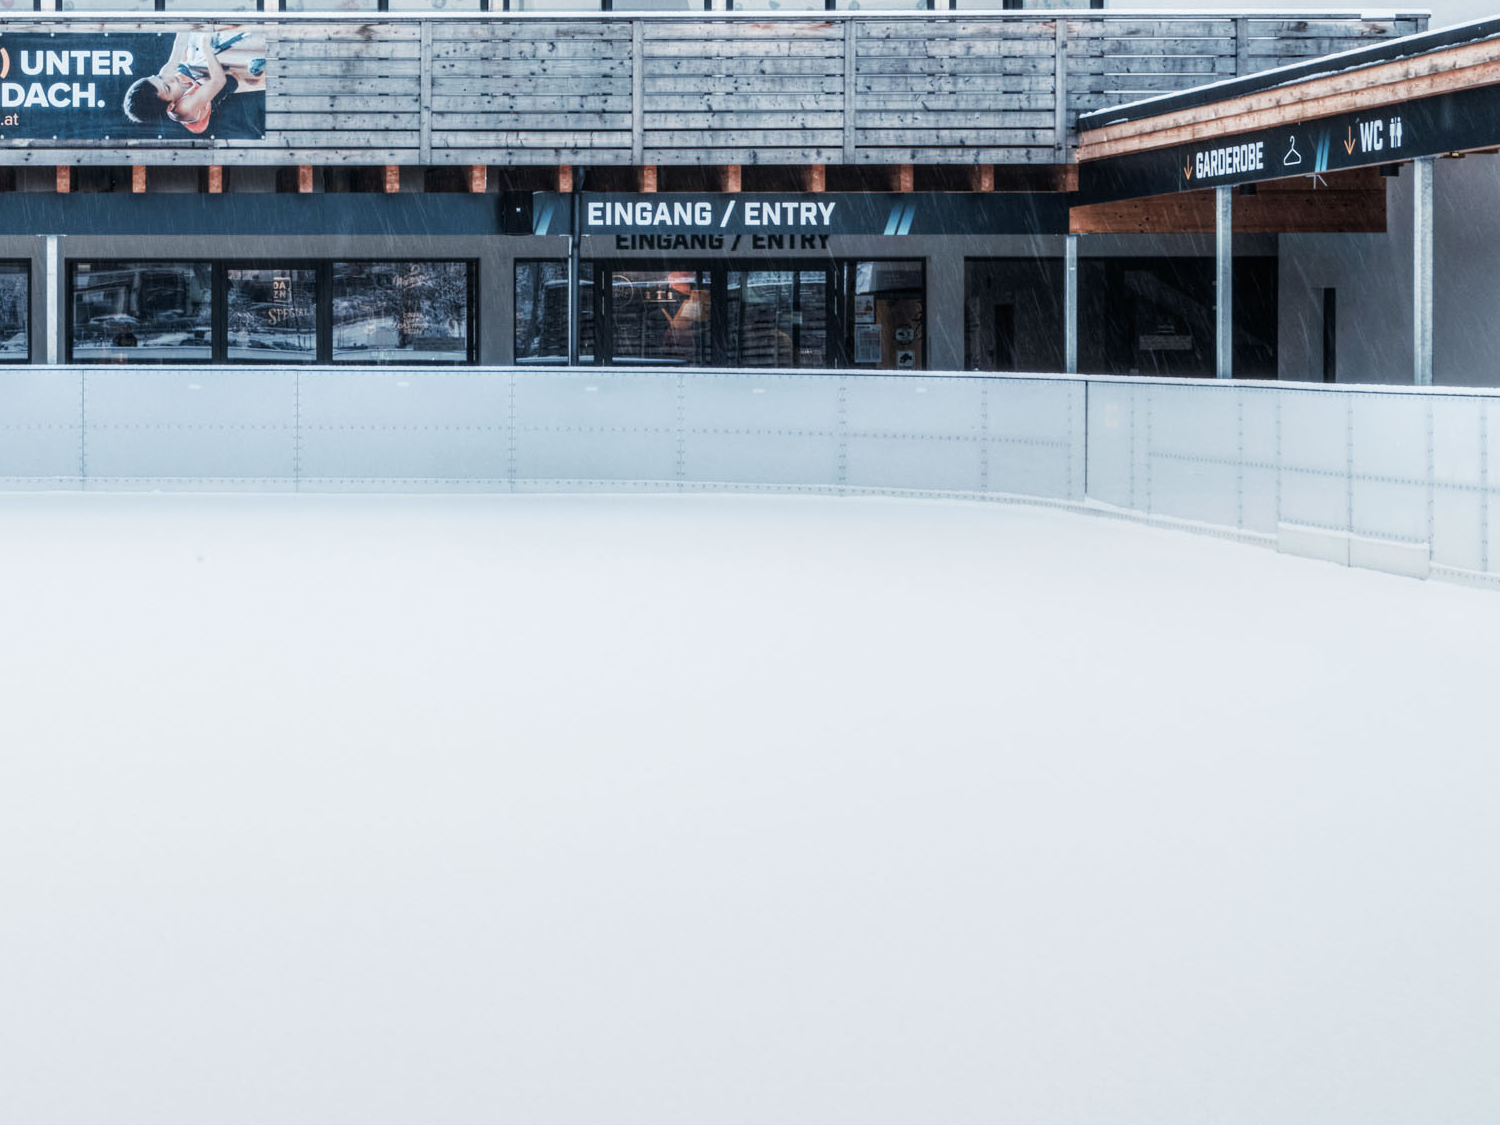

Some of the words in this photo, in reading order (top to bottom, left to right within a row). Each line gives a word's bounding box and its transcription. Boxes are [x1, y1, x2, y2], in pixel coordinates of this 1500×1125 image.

[20, 50, 134, 75] UNTER
[1, 82, 106, 108] DACH.
[1359, 119, 1383, 152] WC
[1195, 141, 1264, 179] GARDEROBE
[587, 202, 712, 226] EINGANG
[744, 202, 836, 226] ENTRY
[615, 235, 724, 250] EINGANG
[752, 235, 831, 250] ENTRY
